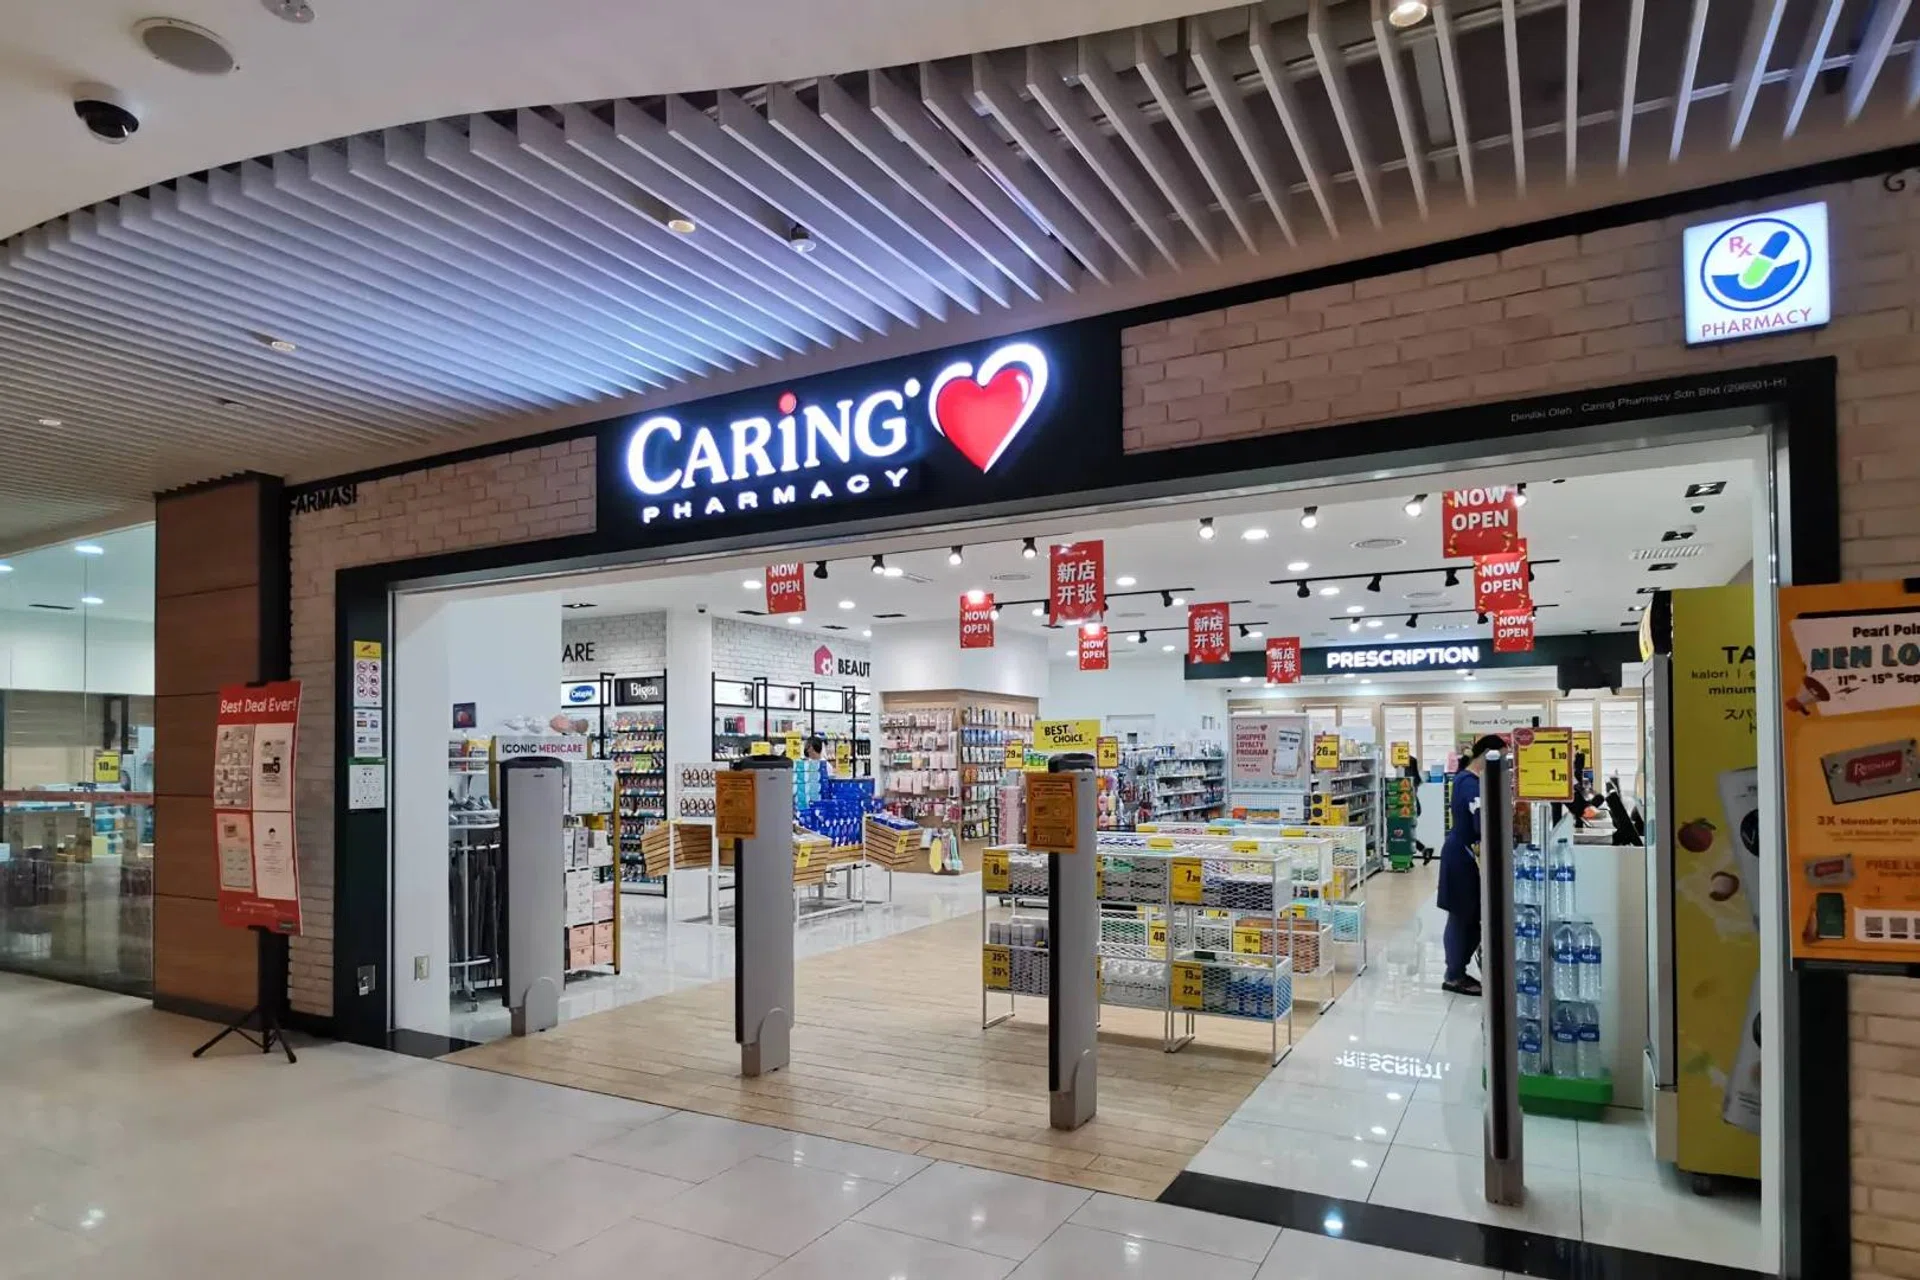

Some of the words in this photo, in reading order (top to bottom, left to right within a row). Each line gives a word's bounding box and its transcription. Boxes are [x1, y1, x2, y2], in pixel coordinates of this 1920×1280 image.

[1701, 307, 1812, 338] PHARMACY
[1617, 393, 1671, 408] Pharmacy
[1674, 389, 1696, 400] Sdn
[1698, 386, 1721, 397] Bhd
[642, 467, 911, 525] PHARMACY
[1453, 487, 1509, 509] NOW
[1450, 509, 1510, 532] OPEN
[770, 563, 799, 578] NOW
[1057, 559, 1097, 583] 新店
[1481, 561, 1522, 578] NOW
[770, 580, 801, 596] OPEN
[1480, 577, 1523, 595] OPEN
[1057, 583, 1097, 606] 开张
[964, 611, 990, 622] NOW
[1194, 615, 1224, 632] 新店
[1499, 614, 1528, 626] NOW
[963, 623, 990, 636] OPEN
[1497, 626, 1529, 639] OPEN
[1852, 624, 1890, 639] Pearl
[1083, 640, 1105, 650] NOW
[1194, 632, 1225, 649] 开张
[561, 642, 596, 663] ARE
[1082, 650, 1106, 660] OPEN
[1270, 647, 1295, 661] 新店
[1326, 646, 1480, 669] PRESCRIPTION
[838, 658, 871, 678] BEAUT
[1270, 660, 1296, 674] 开张
[1691, 669, 1729, 680] kalori
[1871, 672, 1894, 684] 15th
[630, 682, 659, 700] Bigen
[220, 698, 243, 714] Best
[244, 698, 267, 713] Deal
[268, 697, 297, 713] Ever!
[1044, 725, 1069, 736] BEST
[1053, 733, 1084, 744] CHOICE
[502, 744, 537, 754] ICONIC
[538, 743, 583, 754] MEDICARE
